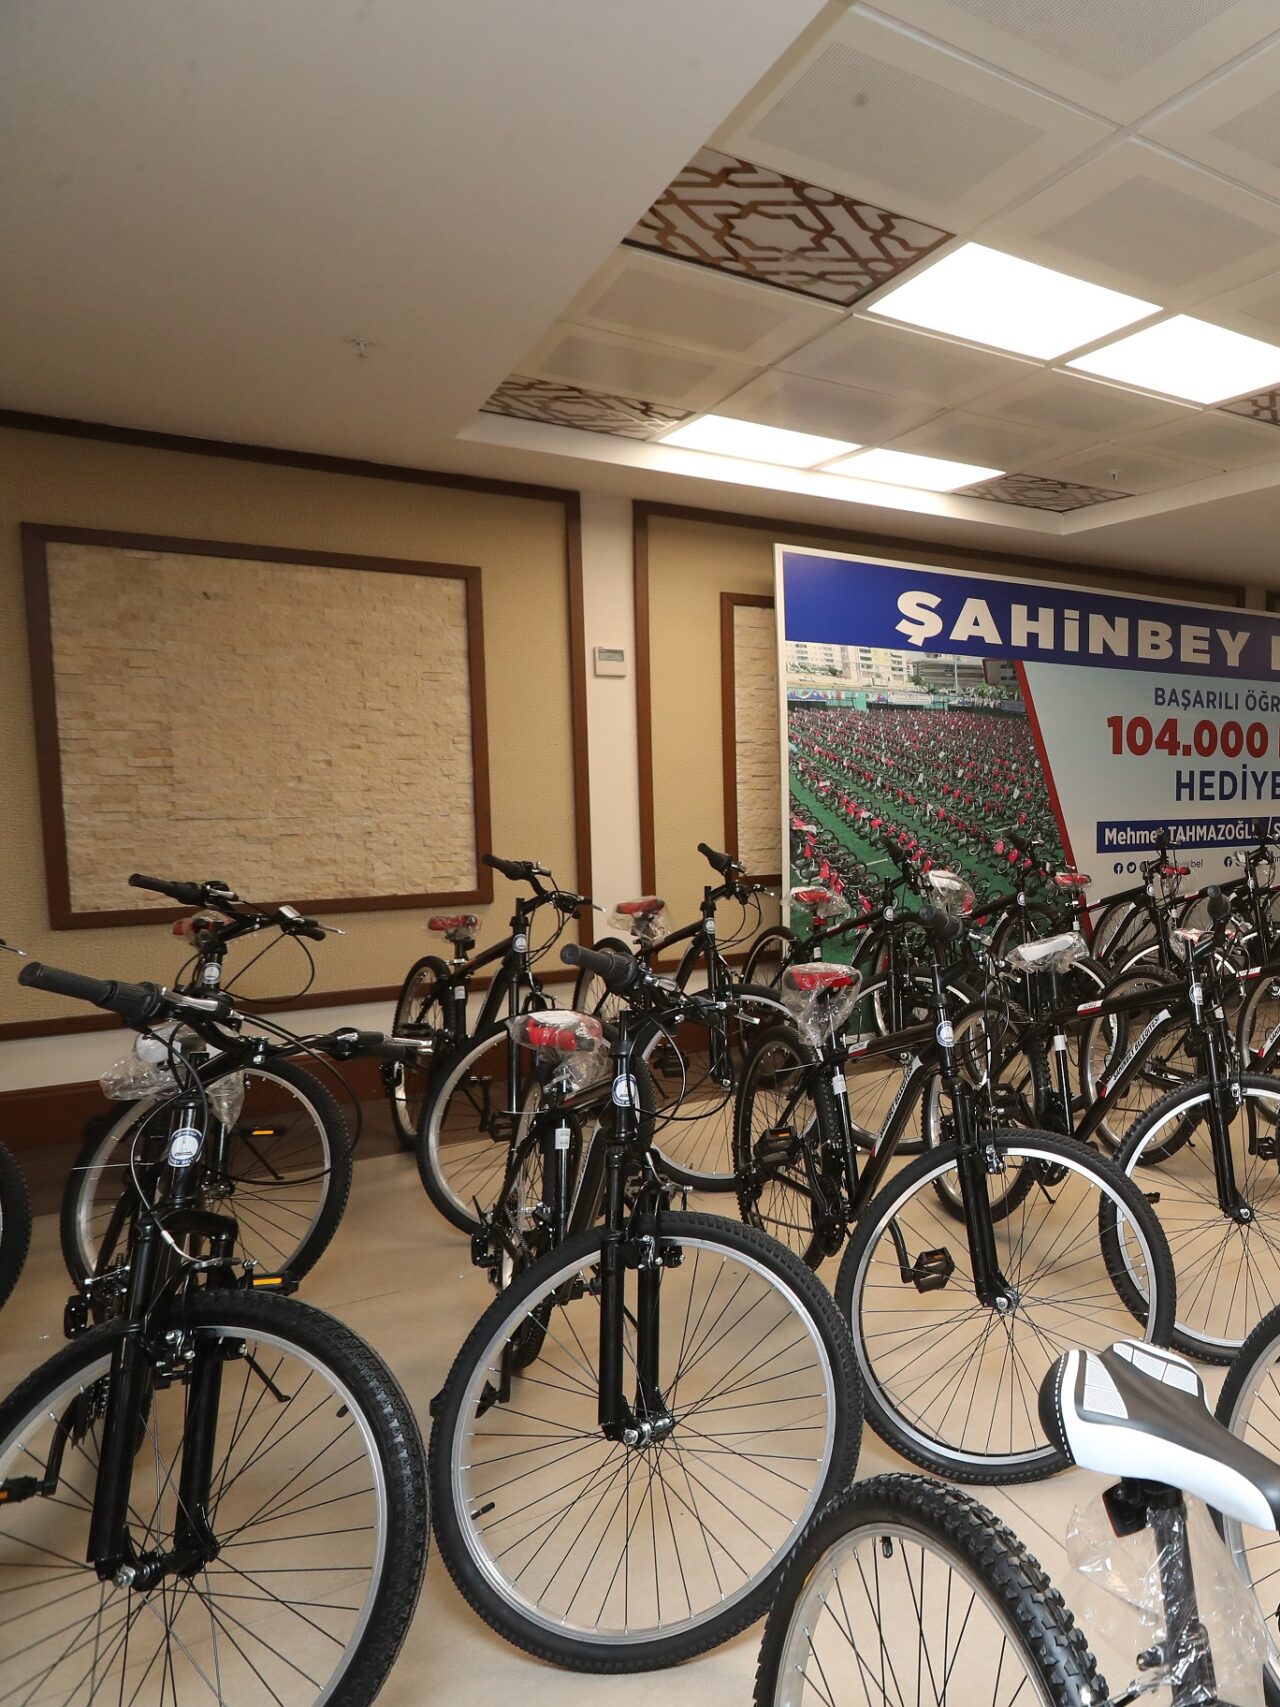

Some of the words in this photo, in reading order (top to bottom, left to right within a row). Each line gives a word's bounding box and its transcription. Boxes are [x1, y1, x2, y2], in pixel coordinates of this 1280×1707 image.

[1154, 687, 1239, 711] BAŞARILI
[1106, 715, 1269, 758] 104.000
[1104, 826, 1160, 846] Mehme
[1168, 820, 1258, 842] TAHMAZOĞL
